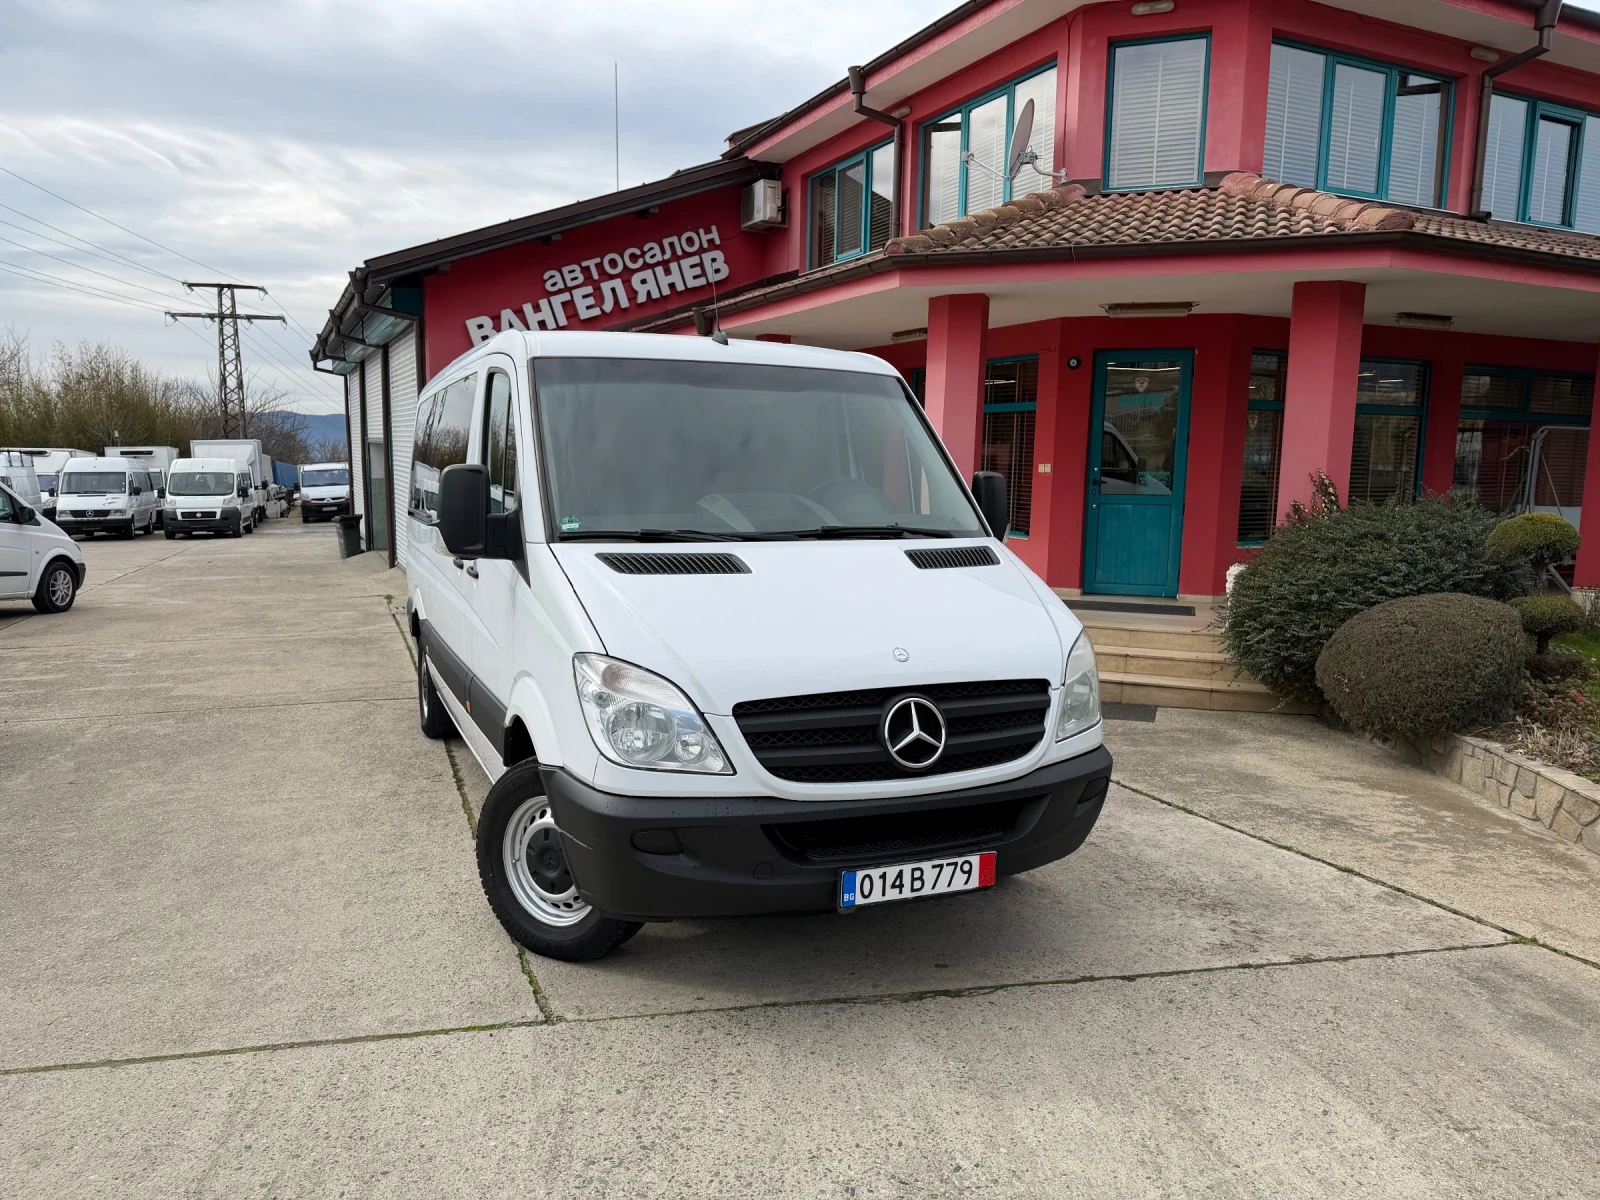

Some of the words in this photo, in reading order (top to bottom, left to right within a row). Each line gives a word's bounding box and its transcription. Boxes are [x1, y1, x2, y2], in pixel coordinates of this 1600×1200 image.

[543, 225, 721, 292] автосалон
[631, 250, 730, 303] ЯНЕВ
[843, 893, 855, 902] BG
